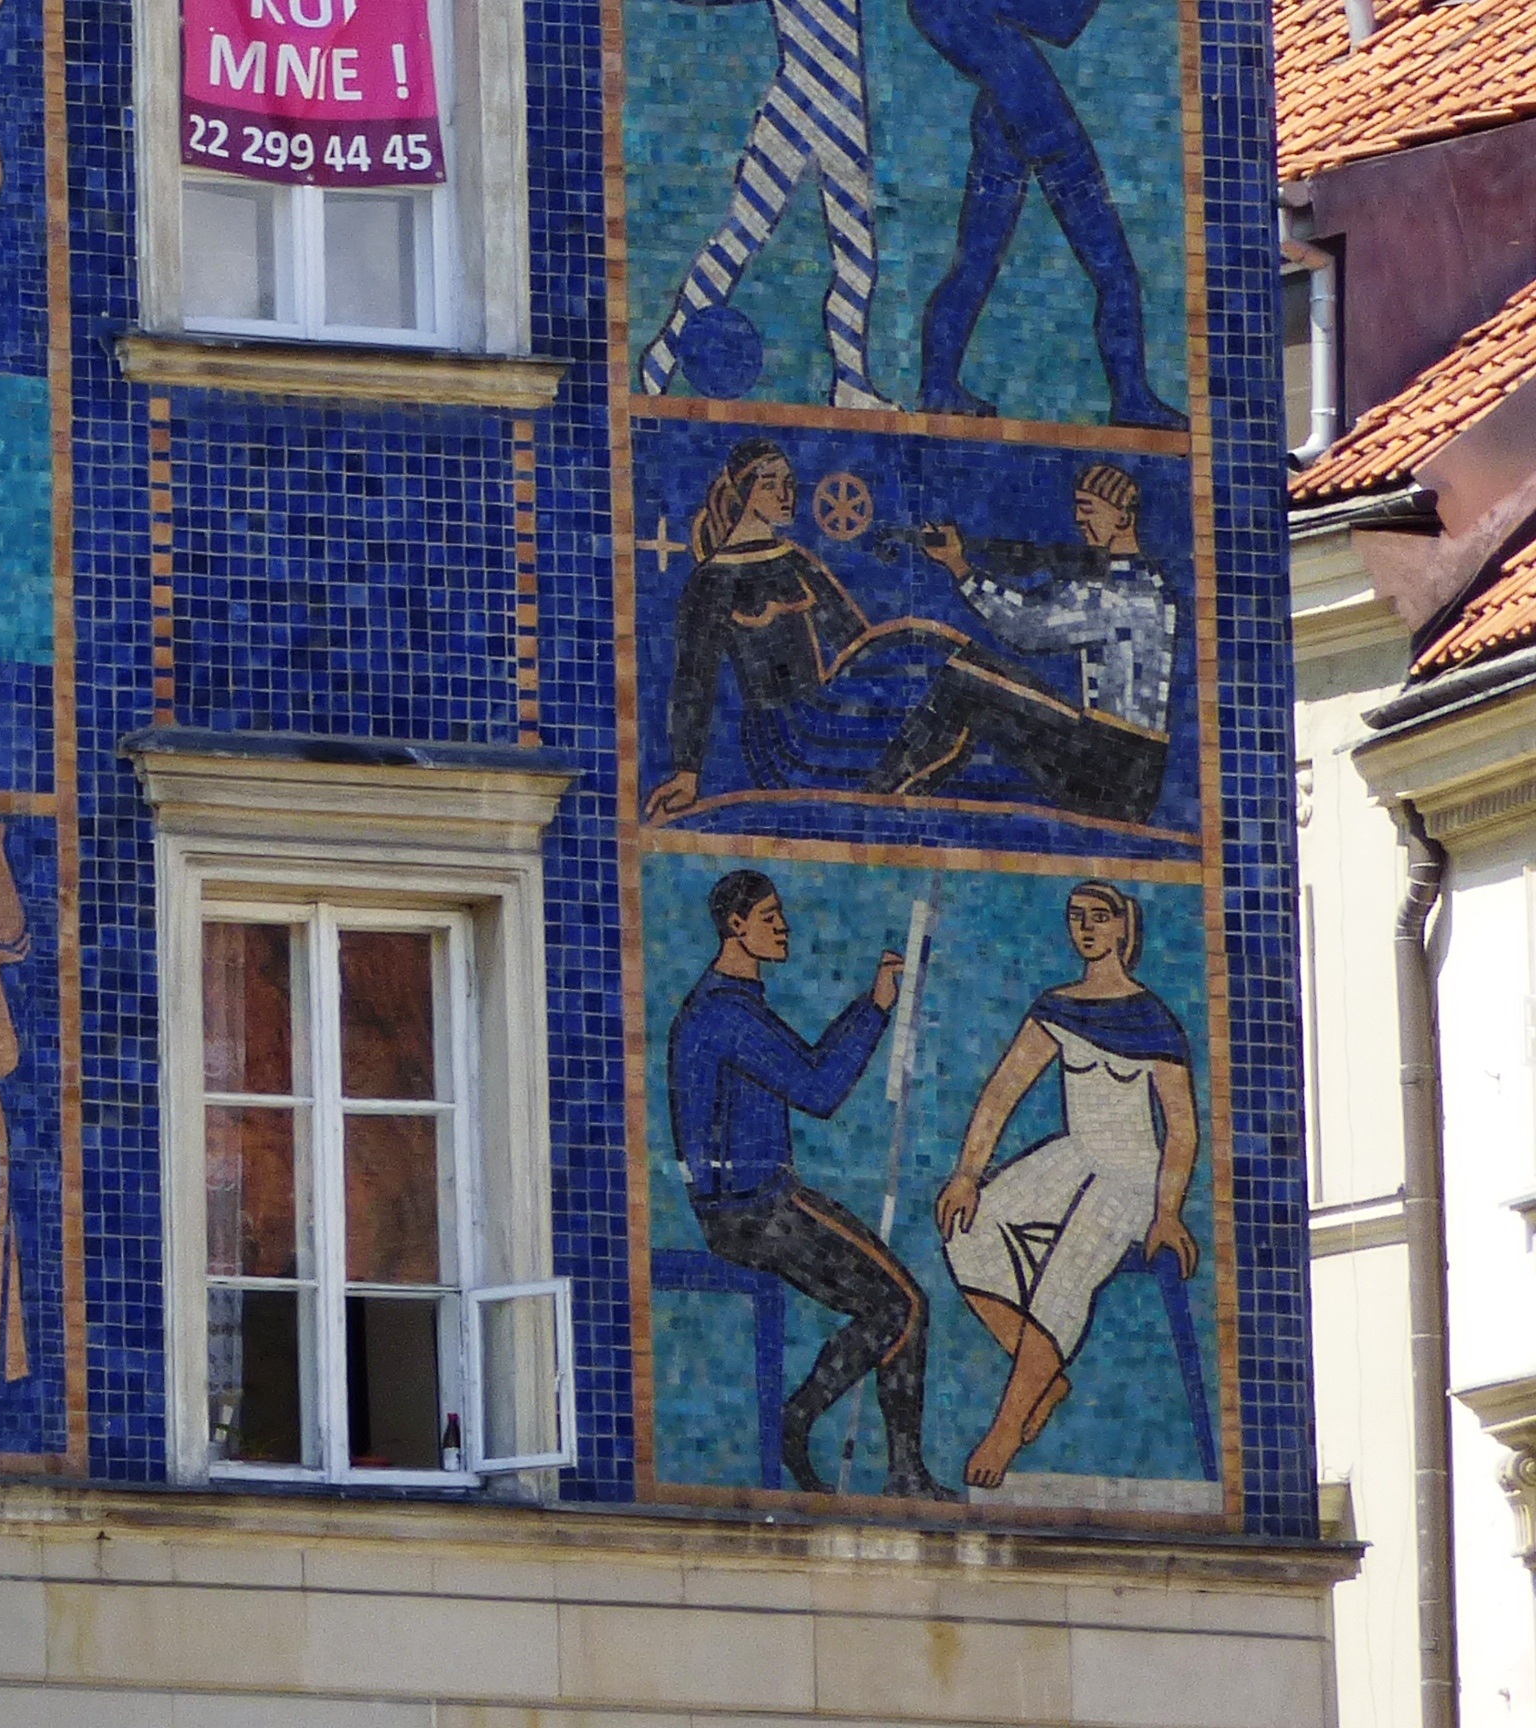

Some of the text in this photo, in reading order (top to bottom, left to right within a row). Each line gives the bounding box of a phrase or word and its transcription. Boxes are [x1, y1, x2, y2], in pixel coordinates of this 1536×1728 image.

[189, 114, 433, 172] 22 299 44 45
